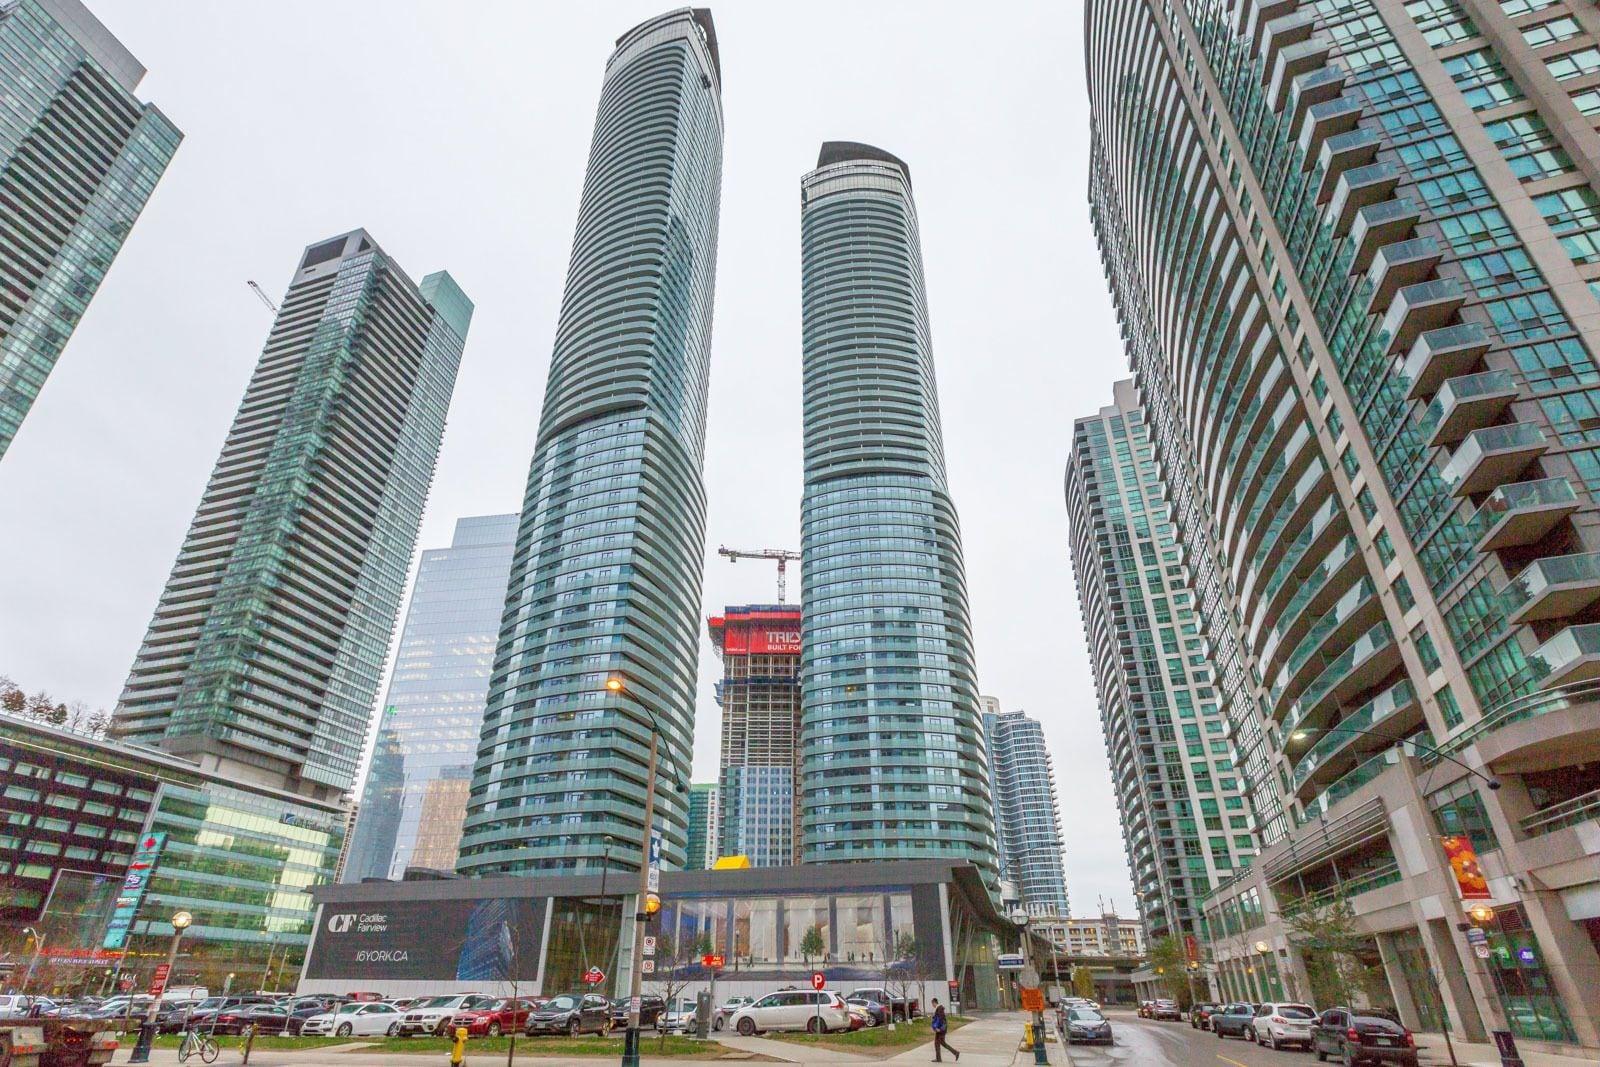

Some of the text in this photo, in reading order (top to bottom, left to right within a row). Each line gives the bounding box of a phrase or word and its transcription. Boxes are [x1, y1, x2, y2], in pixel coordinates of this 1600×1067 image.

[328, 914, 358, 933] CF
[360, 914, 388, 923] Cadillac
[357, 923, 388, 932] Fairview
[355, 951, 408, 962] 16YORK.CA
[814, 975, 823, 988] P
